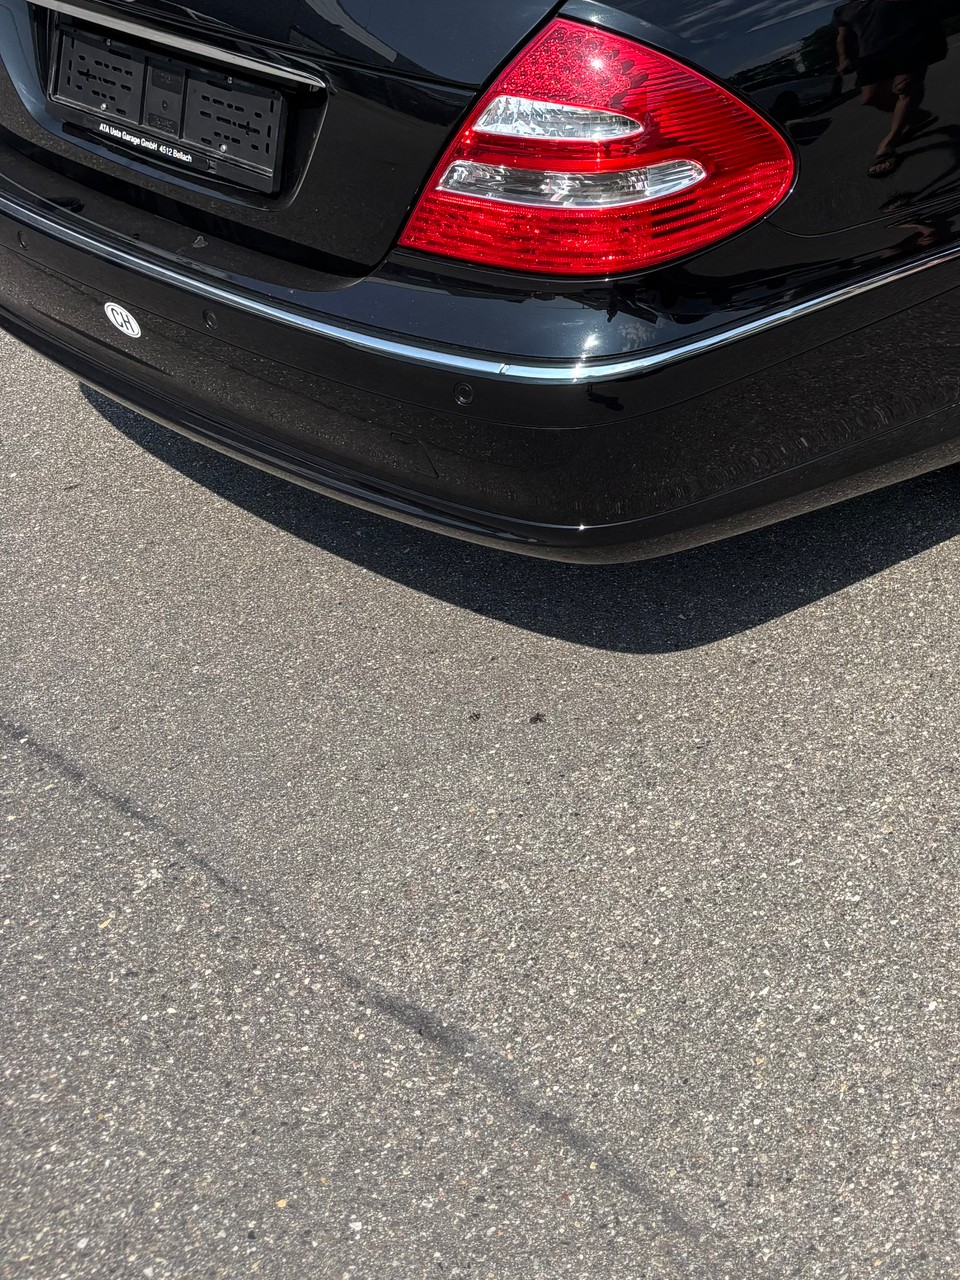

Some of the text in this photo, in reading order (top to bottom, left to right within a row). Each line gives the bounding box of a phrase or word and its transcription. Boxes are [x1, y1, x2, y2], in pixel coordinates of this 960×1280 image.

[99, 123, 110, 134] ATA
[110, 127, 122, 138] Usta
[122, 131, 141, 145] Garage
[141, 138, 158, 151] GmbH
[159, 145, 173, 156] 4512
[110, 307, 135, 333] CH
